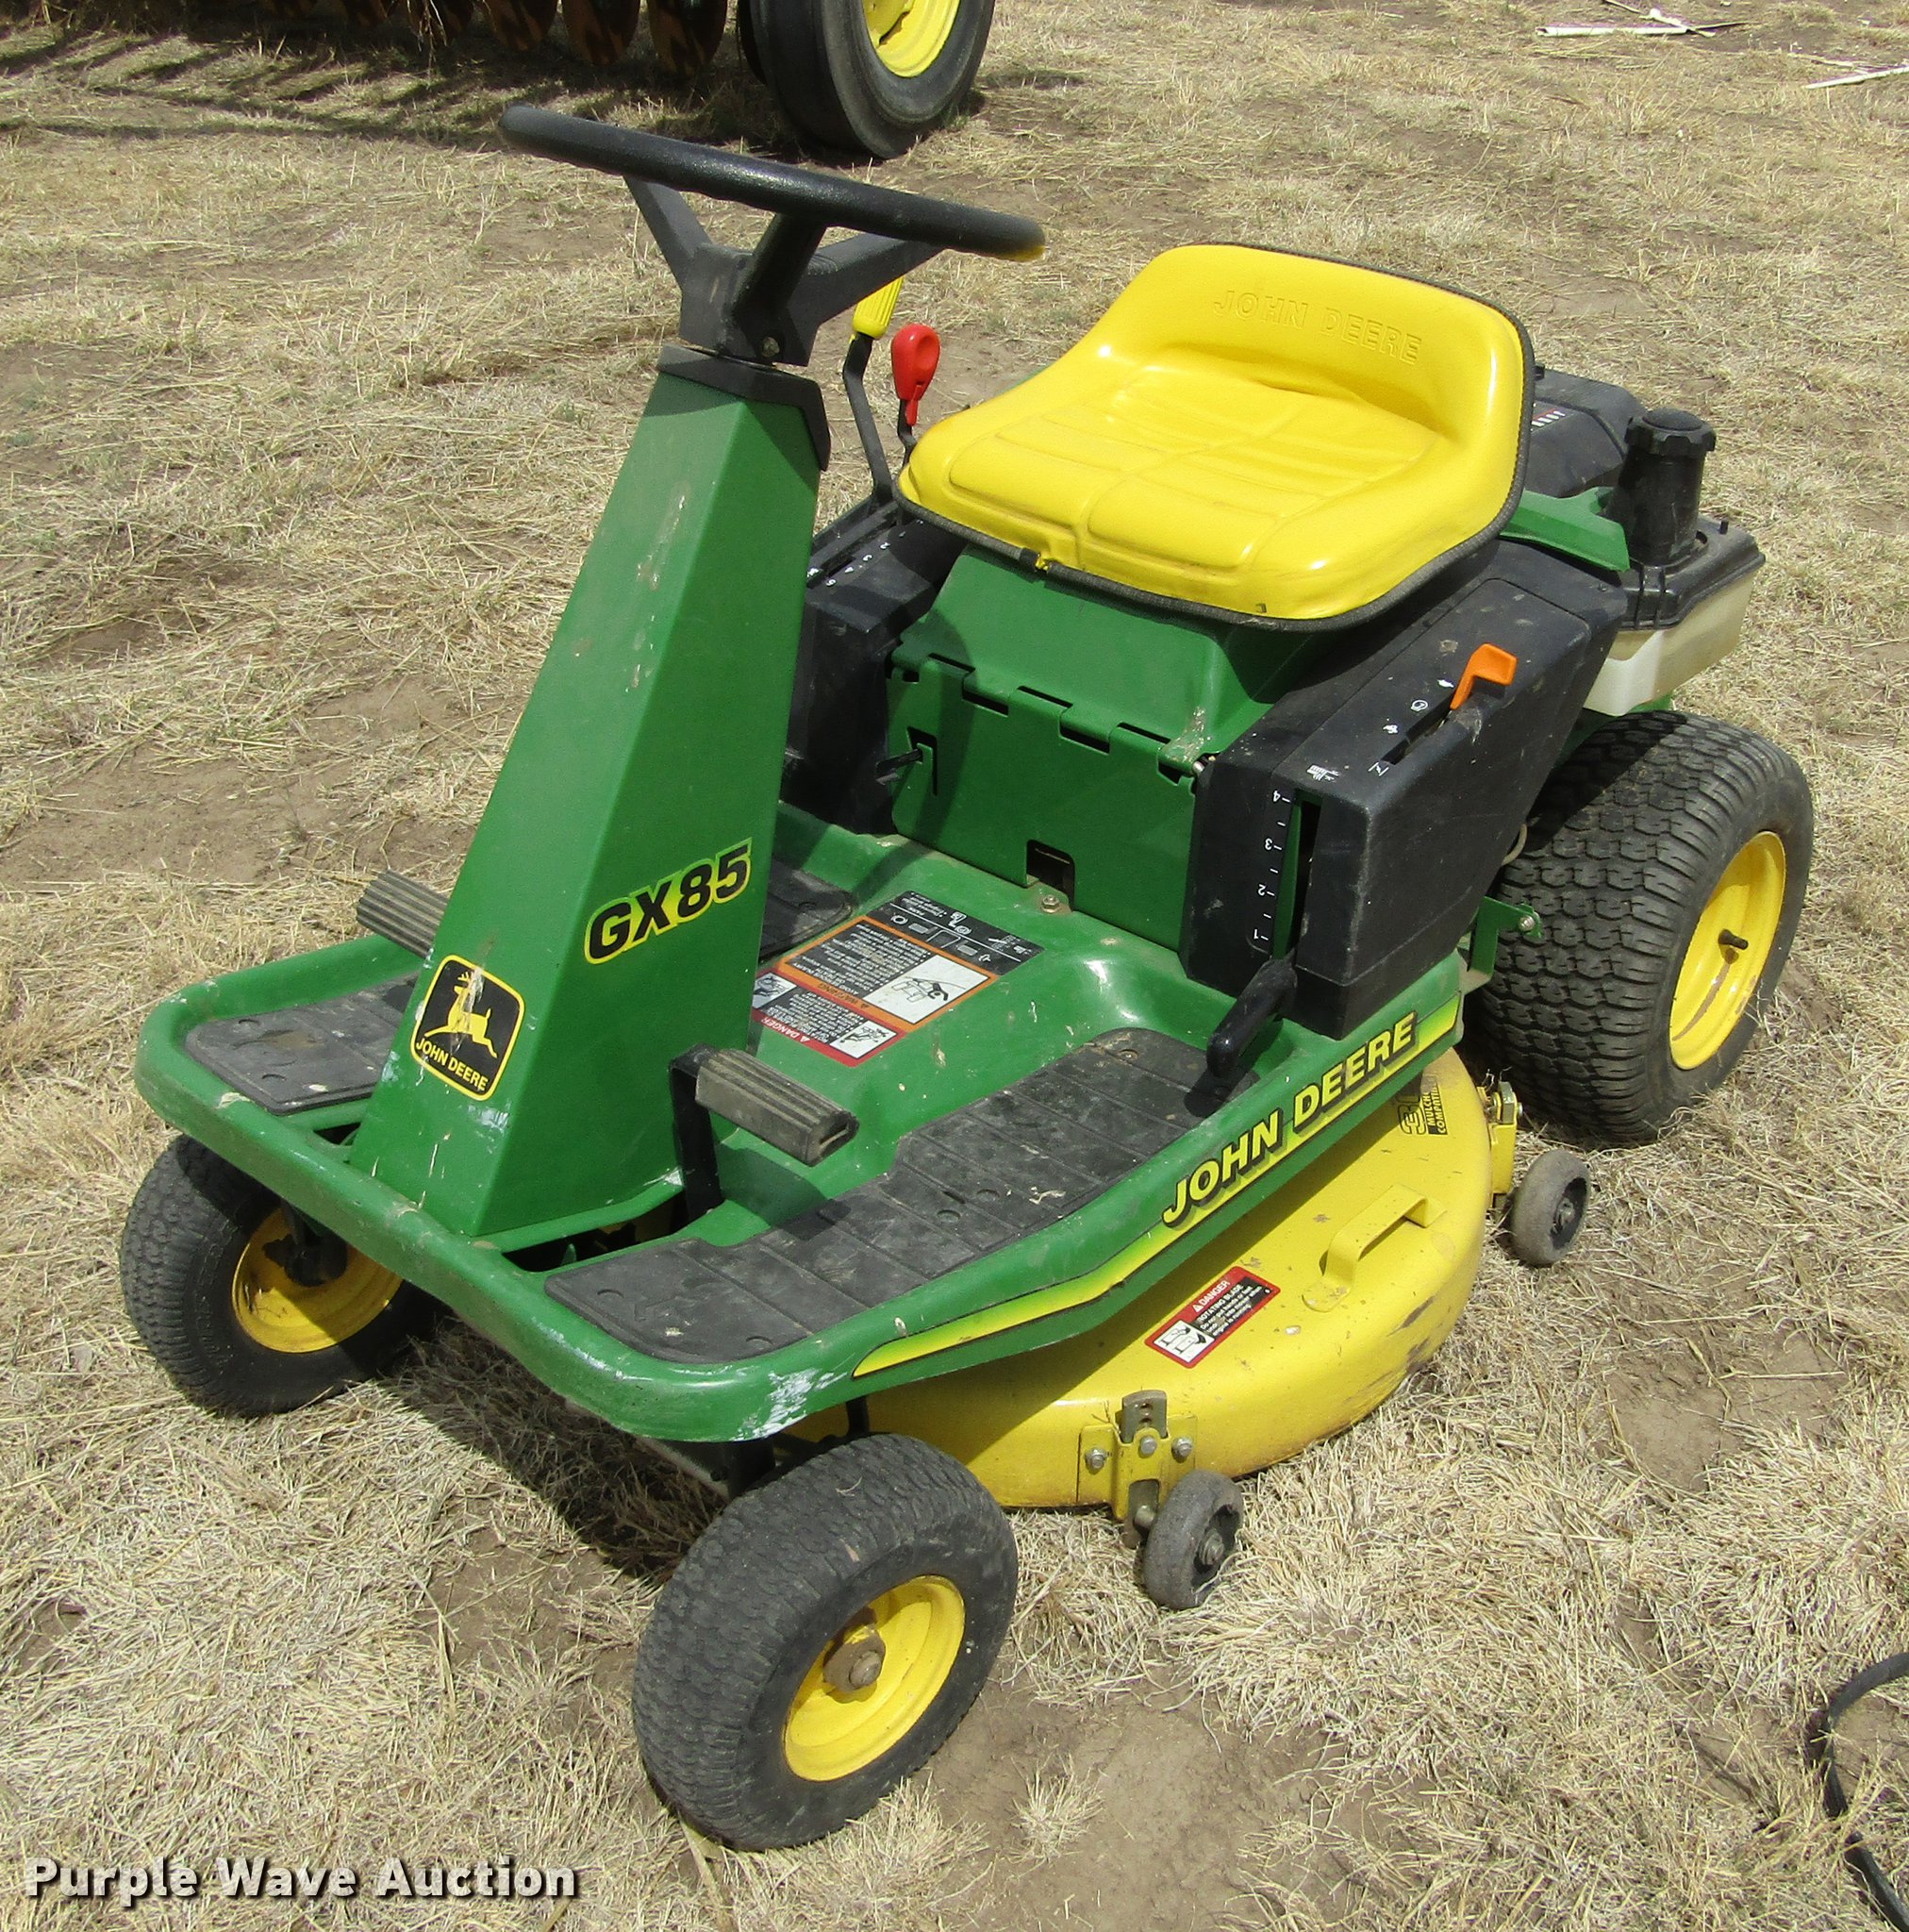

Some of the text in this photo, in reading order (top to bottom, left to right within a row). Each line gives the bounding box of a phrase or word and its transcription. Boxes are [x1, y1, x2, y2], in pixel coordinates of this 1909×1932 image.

[1214, 291, 1422, 366] JOHN DEERE
[589, 844, 750, 960] GX85
[761, 1017, 801, 1039] DANGER
[416, 1038, 489, 1091] JOHN DEERE
[1163, 1011, 1417, 1225] JOHN DEERE
[1198, 1280, 1231, 1306] DANGER
